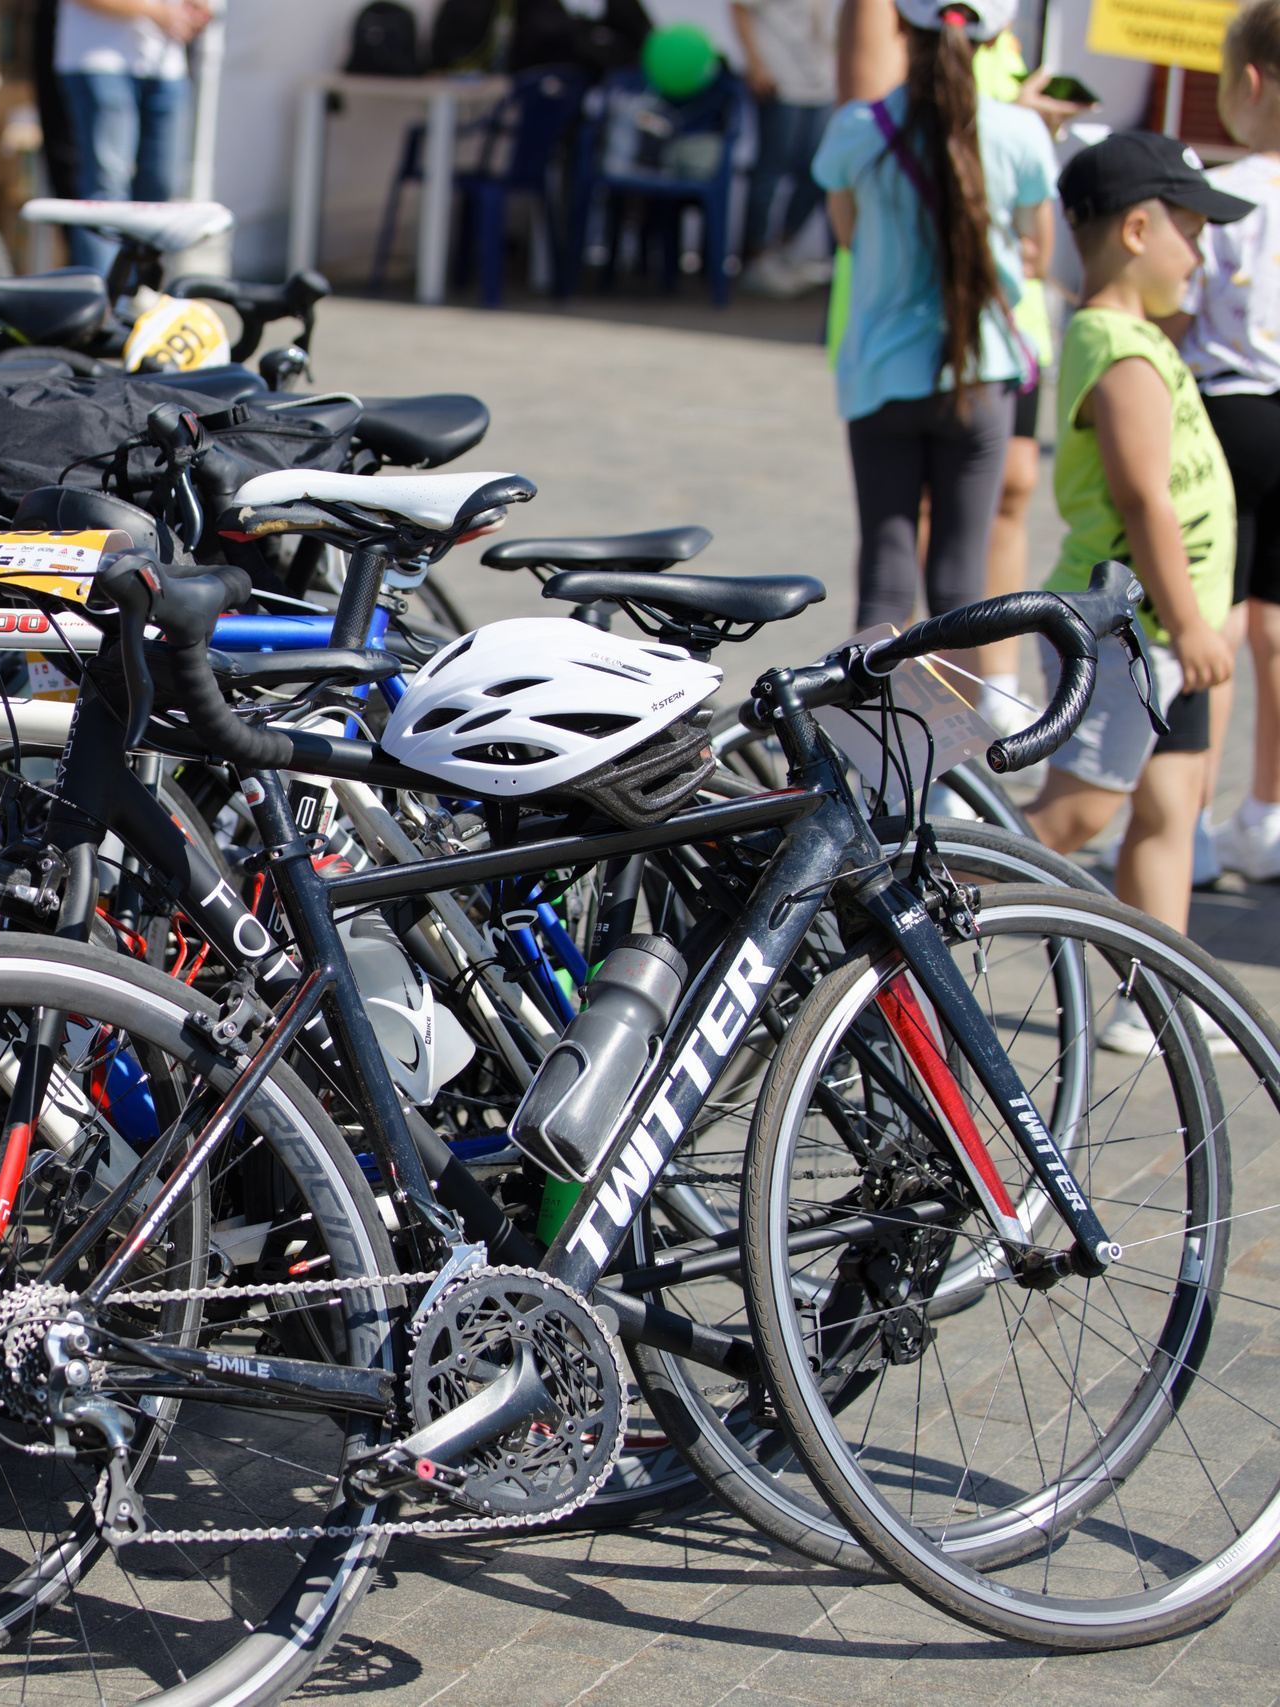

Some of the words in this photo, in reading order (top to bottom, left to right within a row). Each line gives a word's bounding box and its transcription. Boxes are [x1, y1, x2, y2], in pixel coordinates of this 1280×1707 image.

[658, 689, 685, 709] STERN
[566, 937, 775, 1269] TWITTER
[1008, 1091, 1088, 1212] TWITTER
[206, 1354, 270, 1379] SMILE
